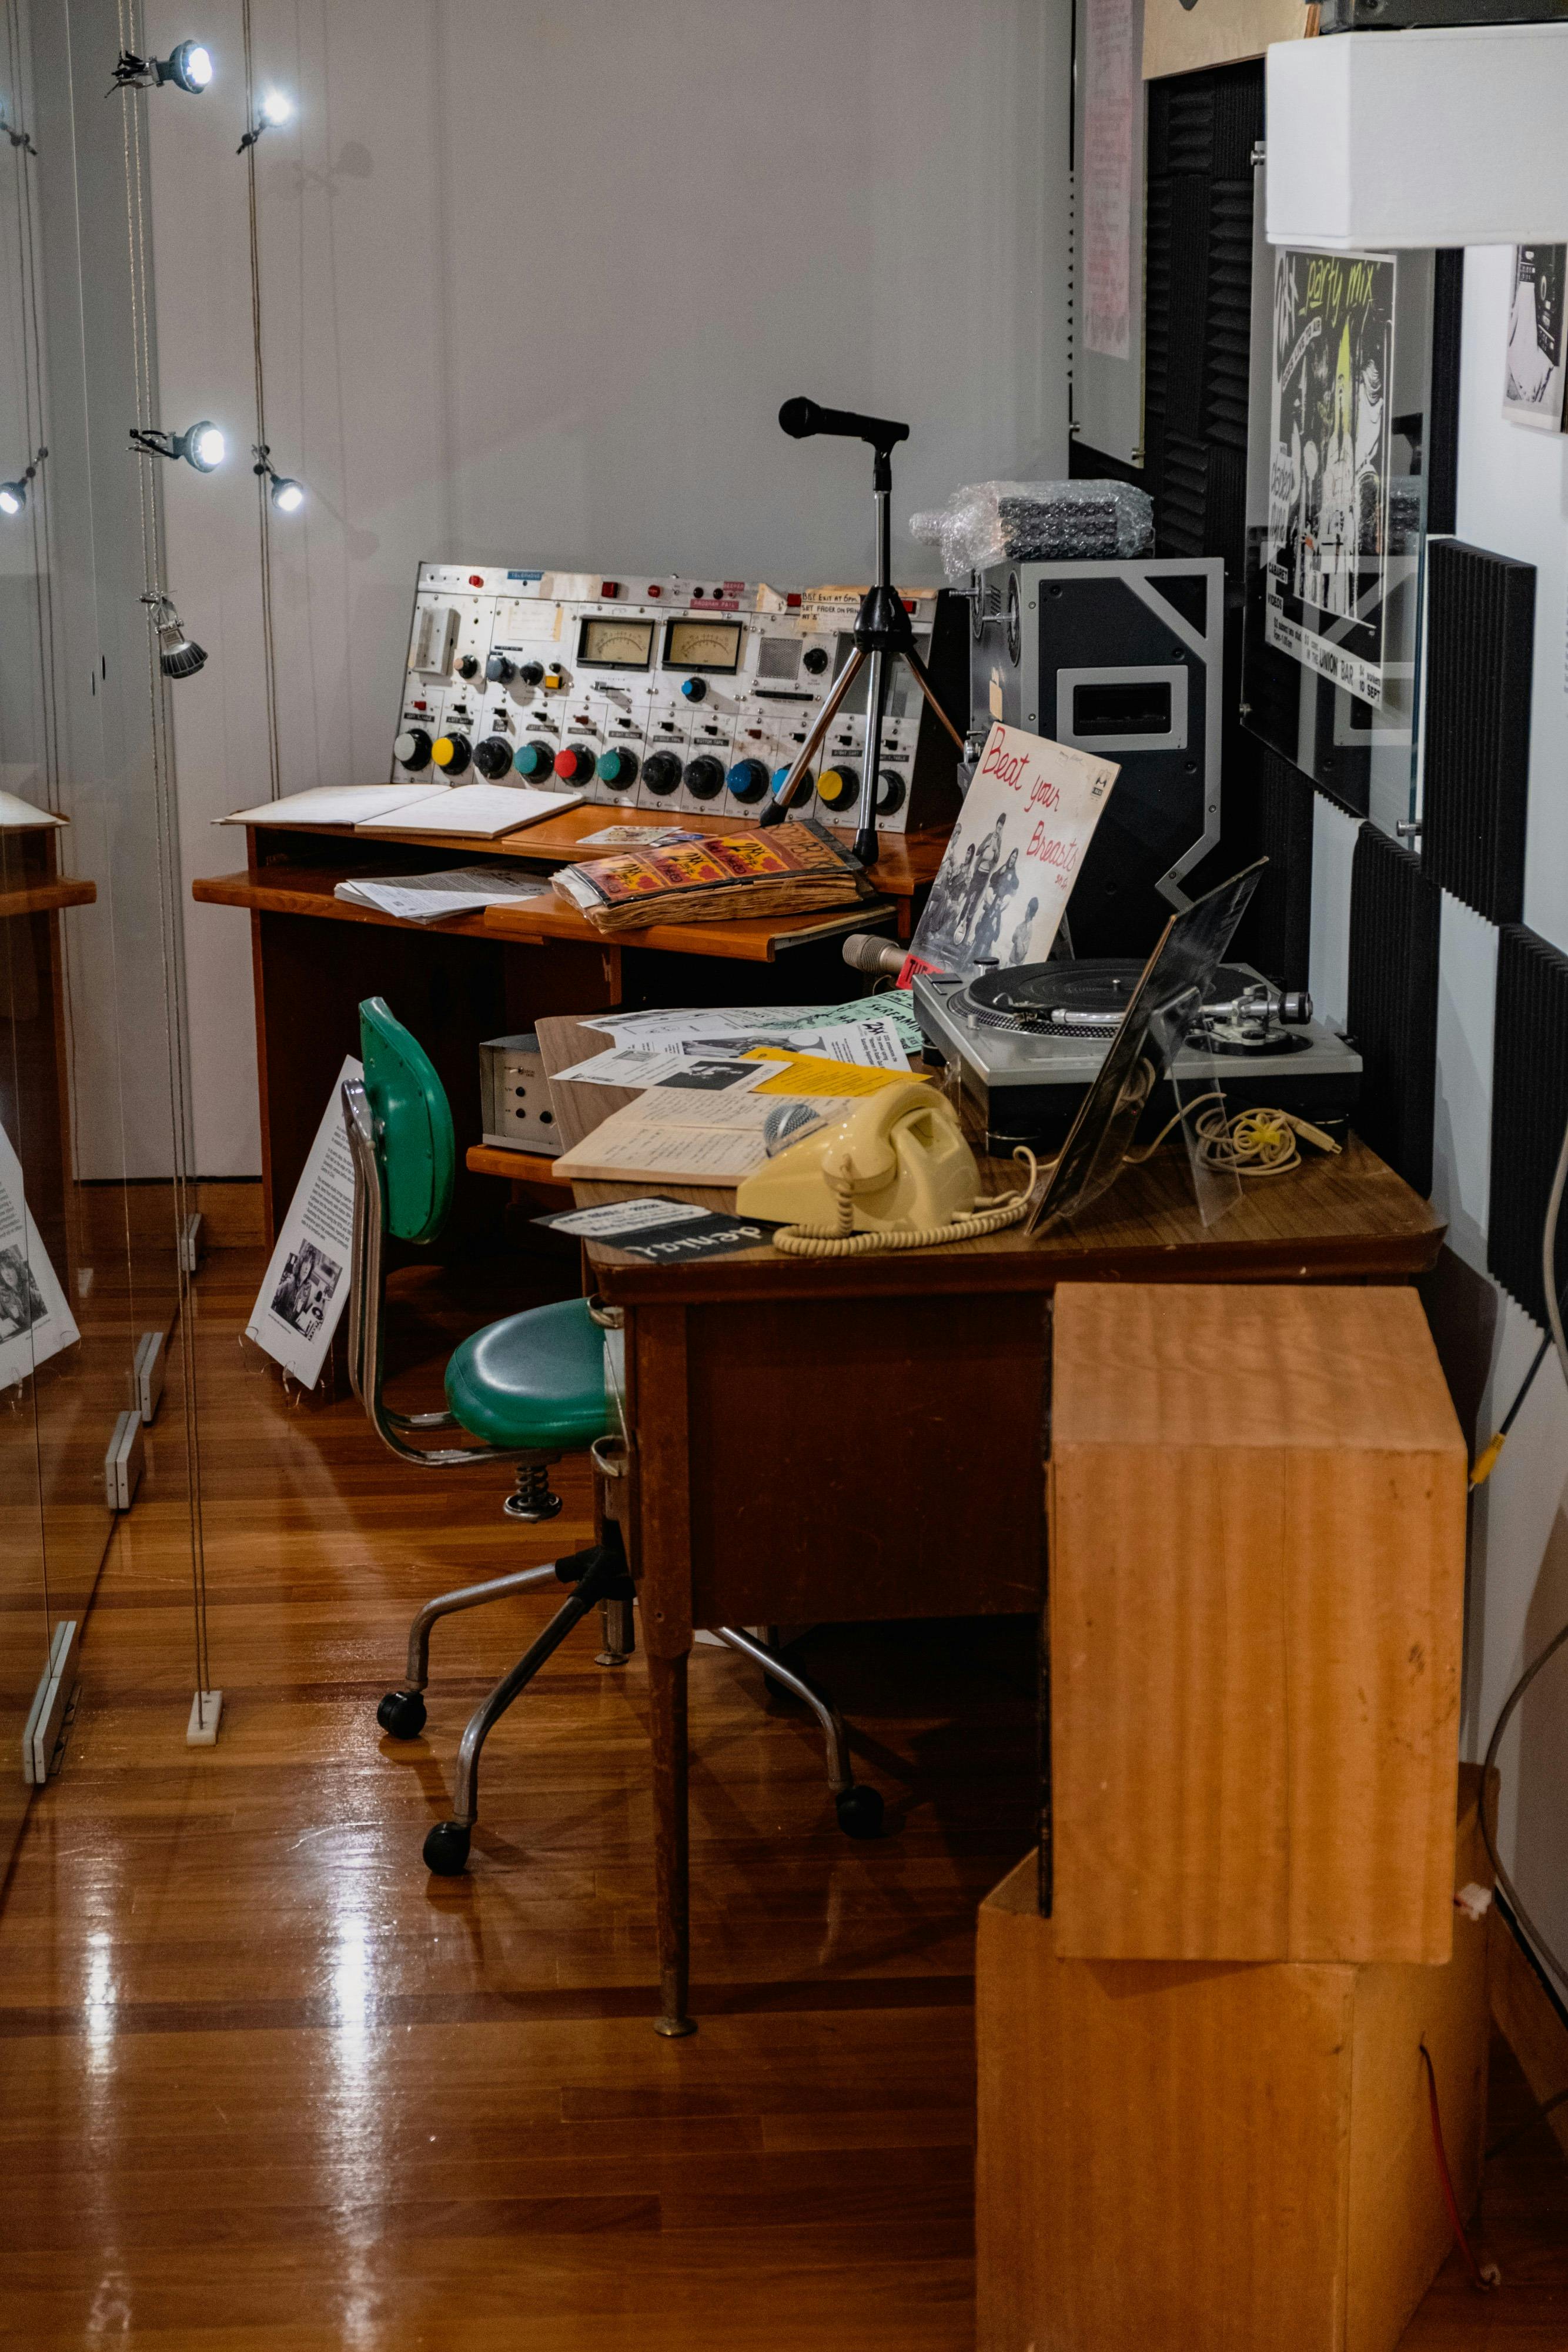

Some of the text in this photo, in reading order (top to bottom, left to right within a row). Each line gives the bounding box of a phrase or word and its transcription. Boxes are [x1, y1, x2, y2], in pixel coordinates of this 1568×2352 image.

[1269, 563, 1288, 582] CABARET
[1268, 593, 1282, 610] VIDEOS
[1319, 647, 1338, 677] UNION
[1340, 659, 1353, 686] BAR
[1367, 683, 1380, 702] SEPT
[982, 727, 1030, 791] Beat
[1024, 773, 1060, 813] your
[1026, 820, 1078, 873] Breasts
[862, 1022, 888, 1035] 2XX
